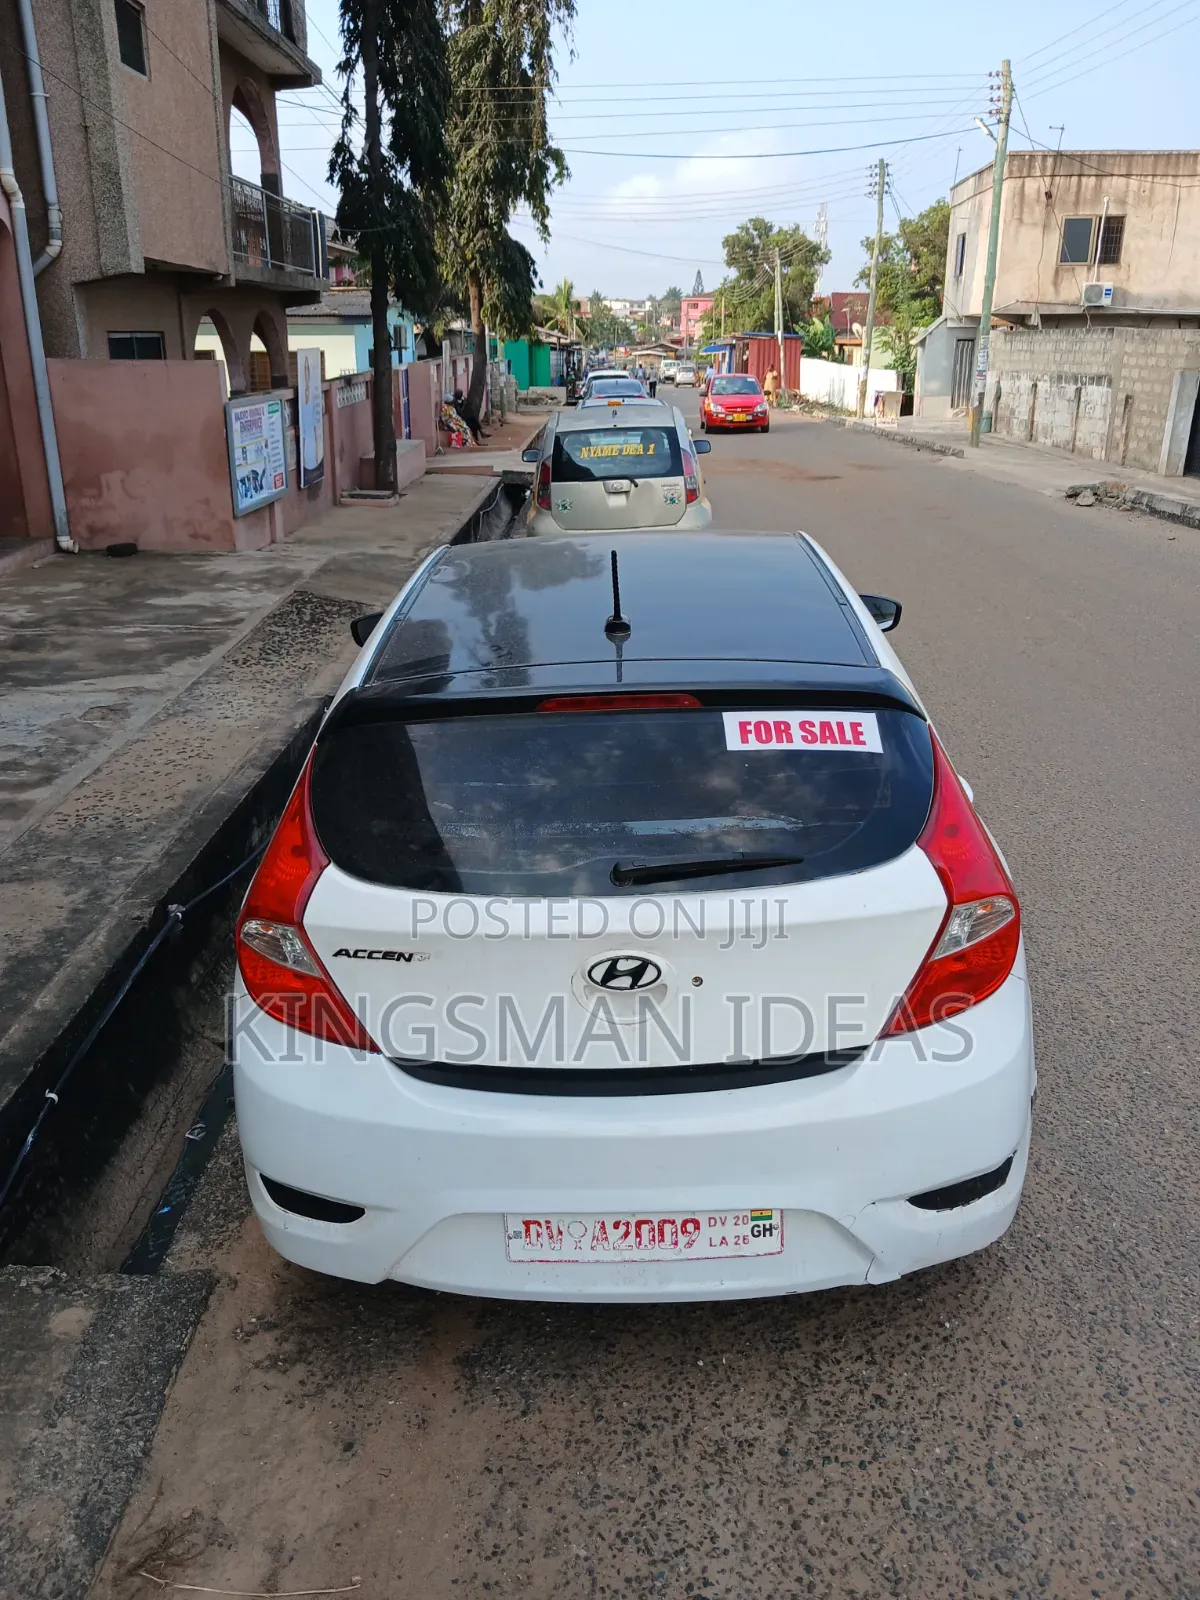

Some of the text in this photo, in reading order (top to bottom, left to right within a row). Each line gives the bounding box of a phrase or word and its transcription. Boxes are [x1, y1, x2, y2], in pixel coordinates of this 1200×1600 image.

[580, 443, 656, 458] NYAME DEA 1
[738, 720, 867, 746] FOR SALE
[332, 948, 431, 962] ACCEN
[707, 1214, 750, 1228] DV 20
[750, 1222, 774, 1239] GH
[708, 1235, 729, 1248] LA
